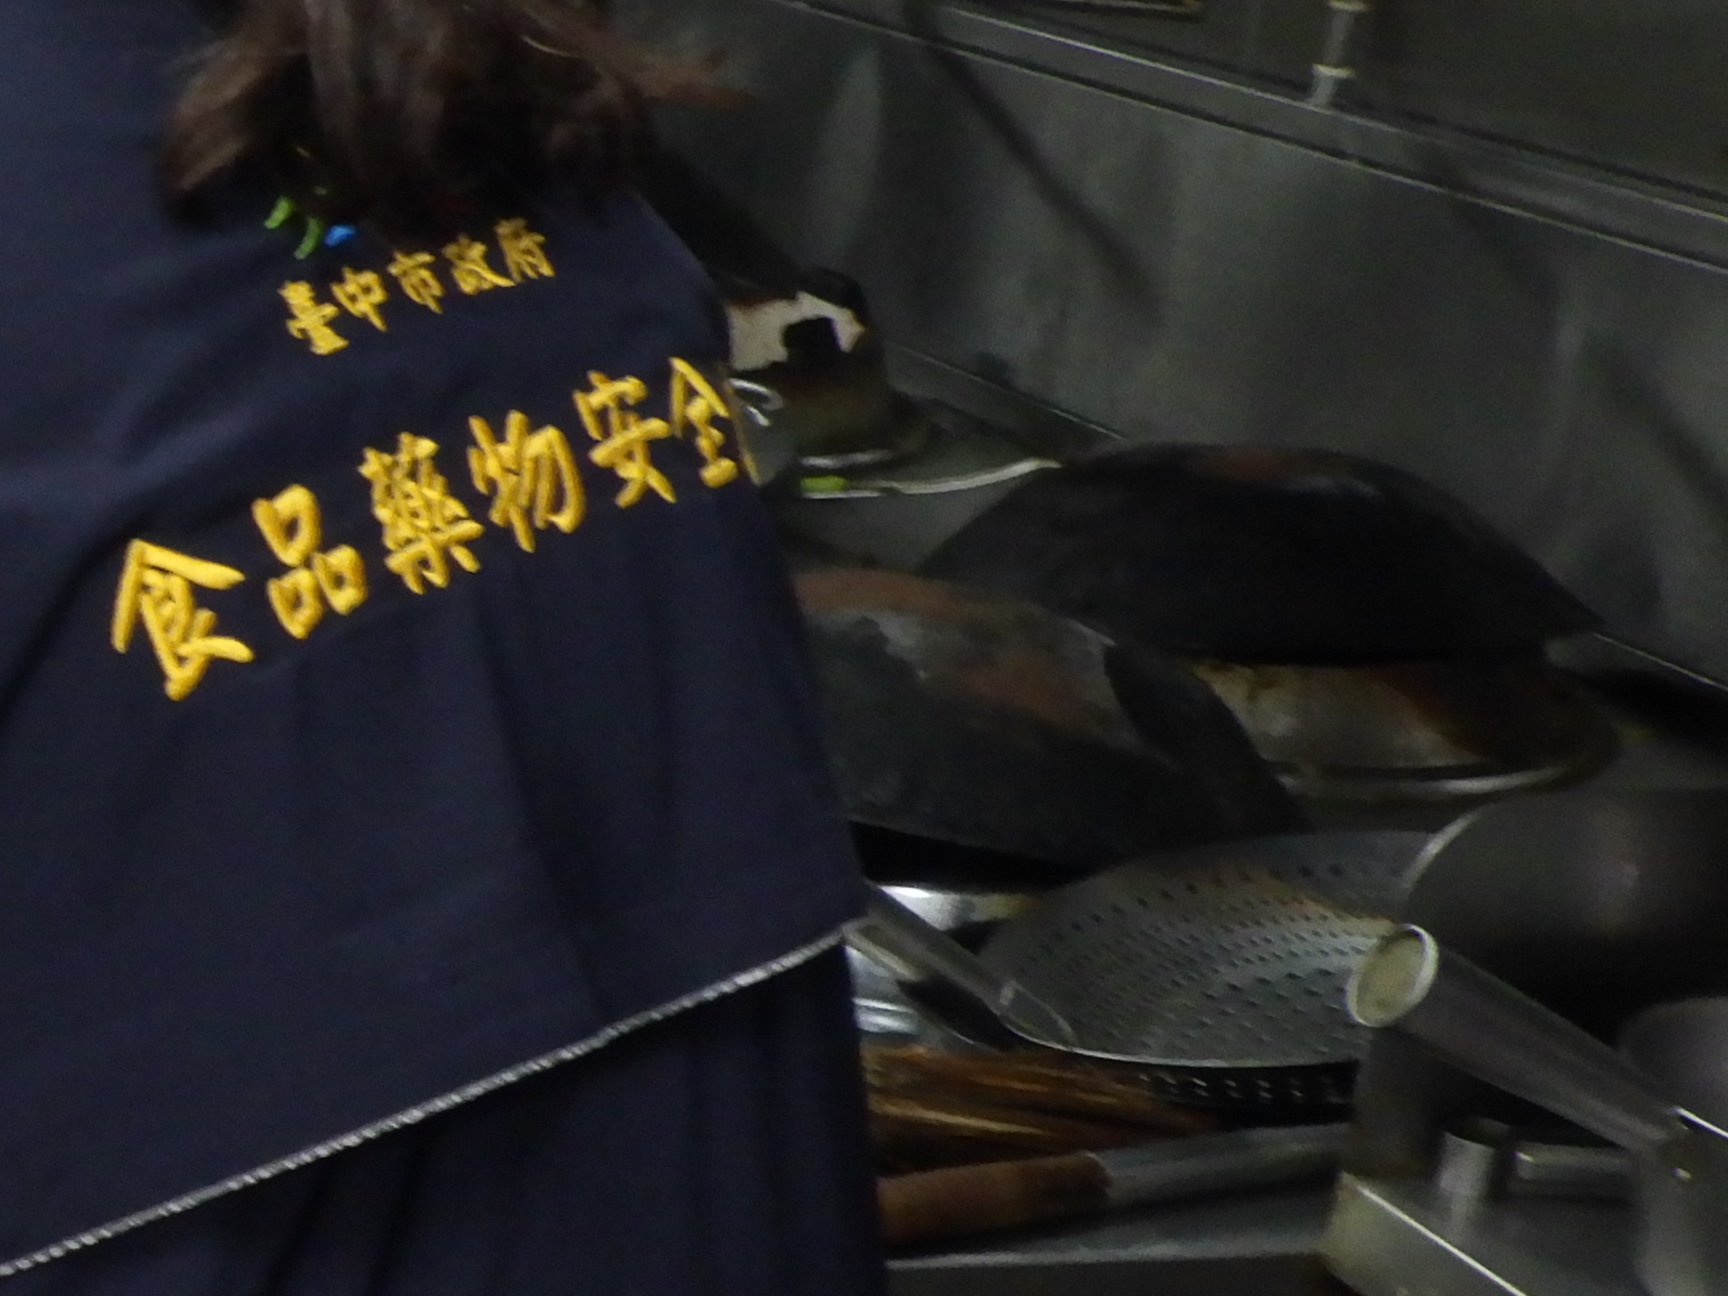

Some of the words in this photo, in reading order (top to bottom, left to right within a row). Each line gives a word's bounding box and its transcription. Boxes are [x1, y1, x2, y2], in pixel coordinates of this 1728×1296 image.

[111, 355, 762, 701] 食品藥物安全
